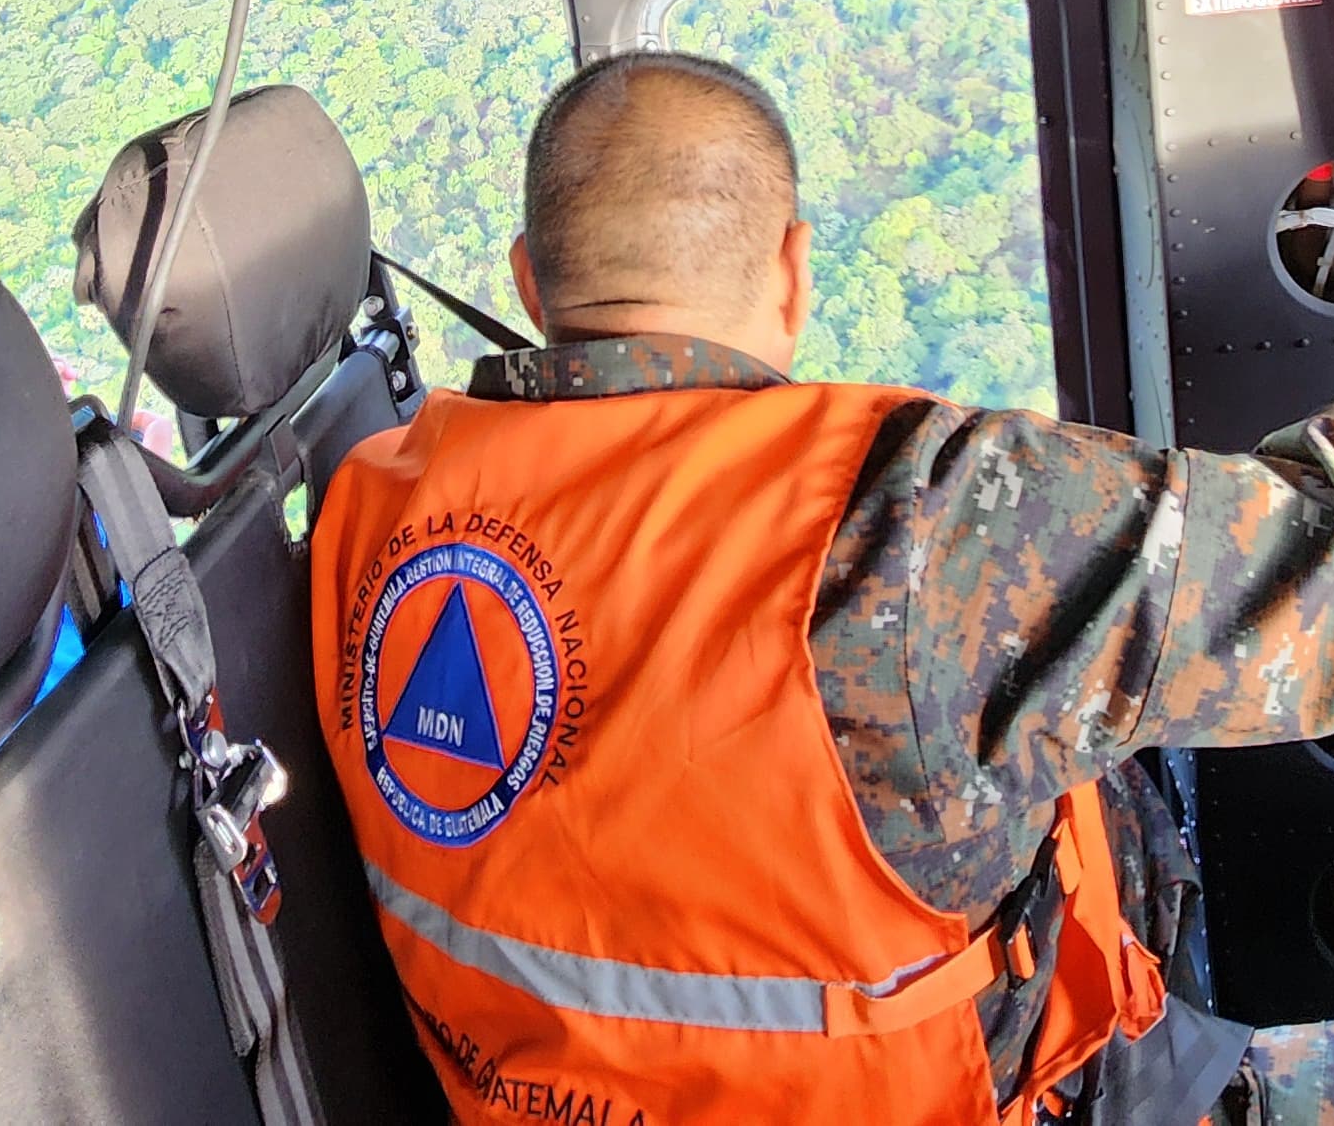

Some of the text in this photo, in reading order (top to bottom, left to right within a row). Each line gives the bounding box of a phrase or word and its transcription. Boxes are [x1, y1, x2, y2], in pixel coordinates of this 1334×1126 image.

[453, 552, 507, 591] INTEGRAL
[505, 580, 523, 607] DE
[342, 512, 586, 786] MINISTERIO DE LA DEFENSA NACIONAL
[514, 599, 554, 688] REDUCCION
[417, 707, 464, 748] MDN
[535, 688, 553, 717] DE
[507, 713, 547, 791] RIESGOS
[376, 766, 505, 838] REPUBLICA DE GUATEMALA
